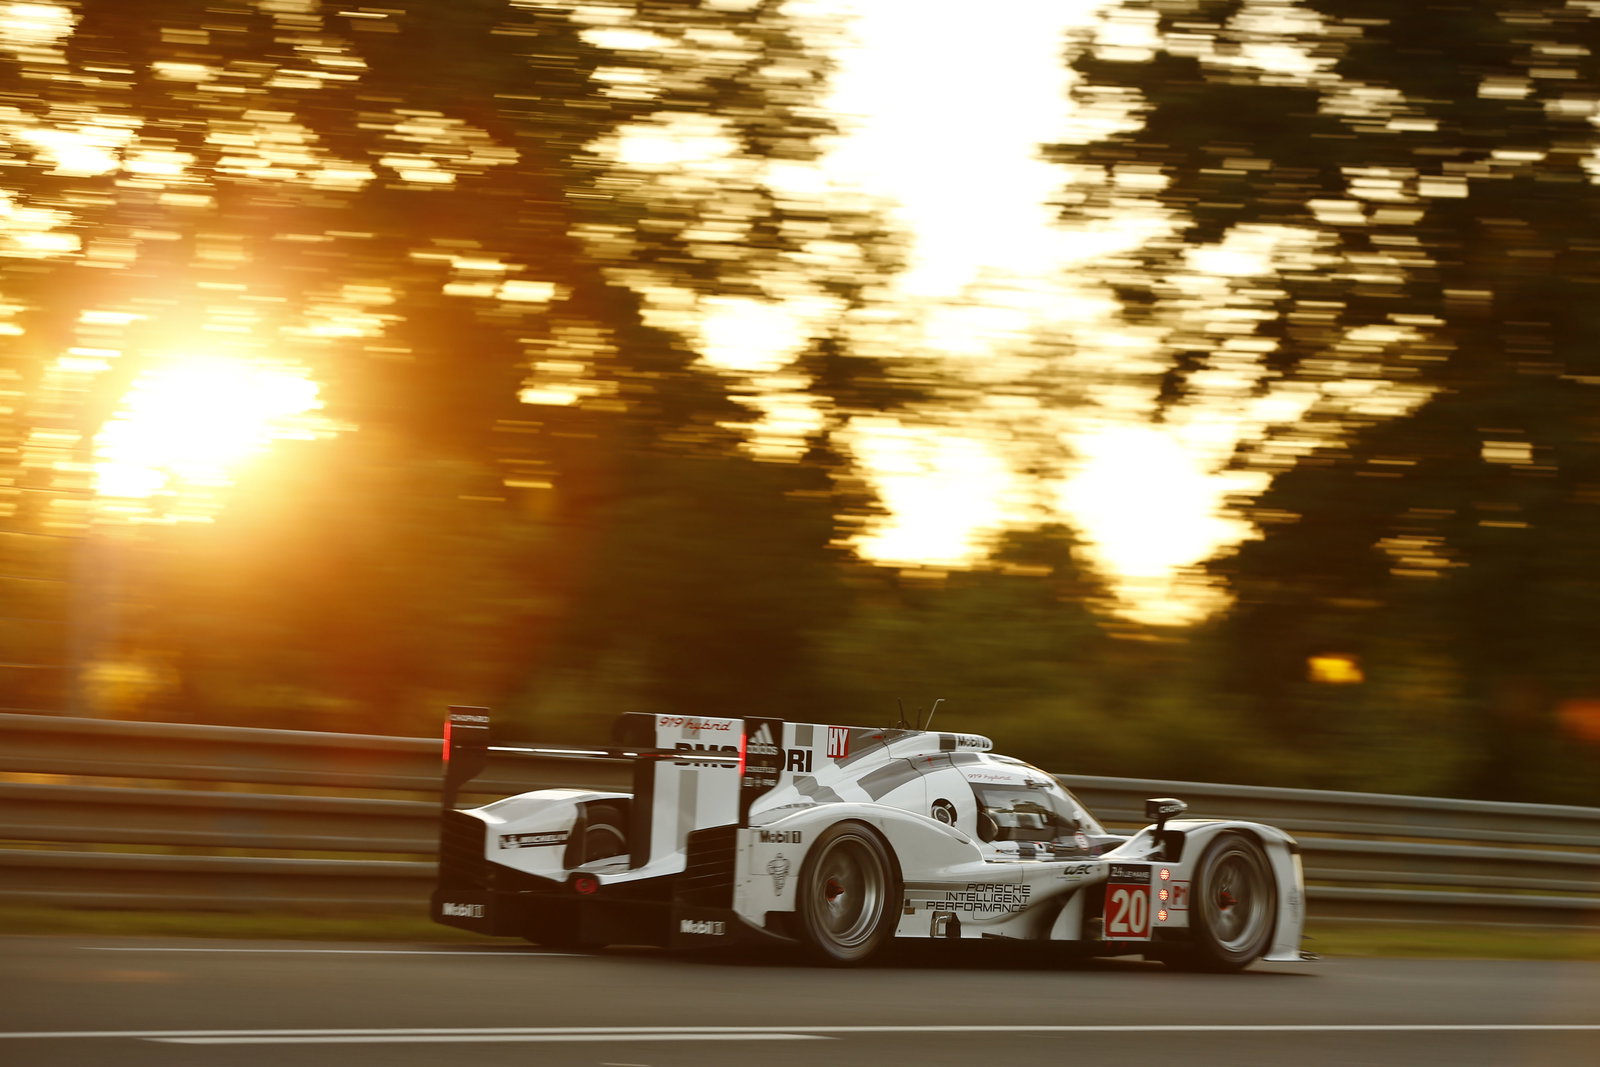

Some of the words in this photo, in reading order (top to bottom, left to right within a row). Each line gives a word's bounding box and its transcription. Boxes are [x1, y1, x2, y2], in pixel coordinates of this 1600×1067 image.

[659, 716, 684, 727] 919
[684, 718, 732, 735] hybrid
[828, 728, 849, 757] HY
[759, 830, 790, 844] Mobil
[1063, 865, 1093, 875] WEC
[966, 883, 1031, 894] PORSCHE
[946, 892, 1030, 903] INTELLIGENT
[442, 902, 473, 917] Mobil
[926, 901, 1028, 913] PERFORMANCE
[1110, 889, 1147, 933] 20
[680, 919, 713, 935] Mobil
